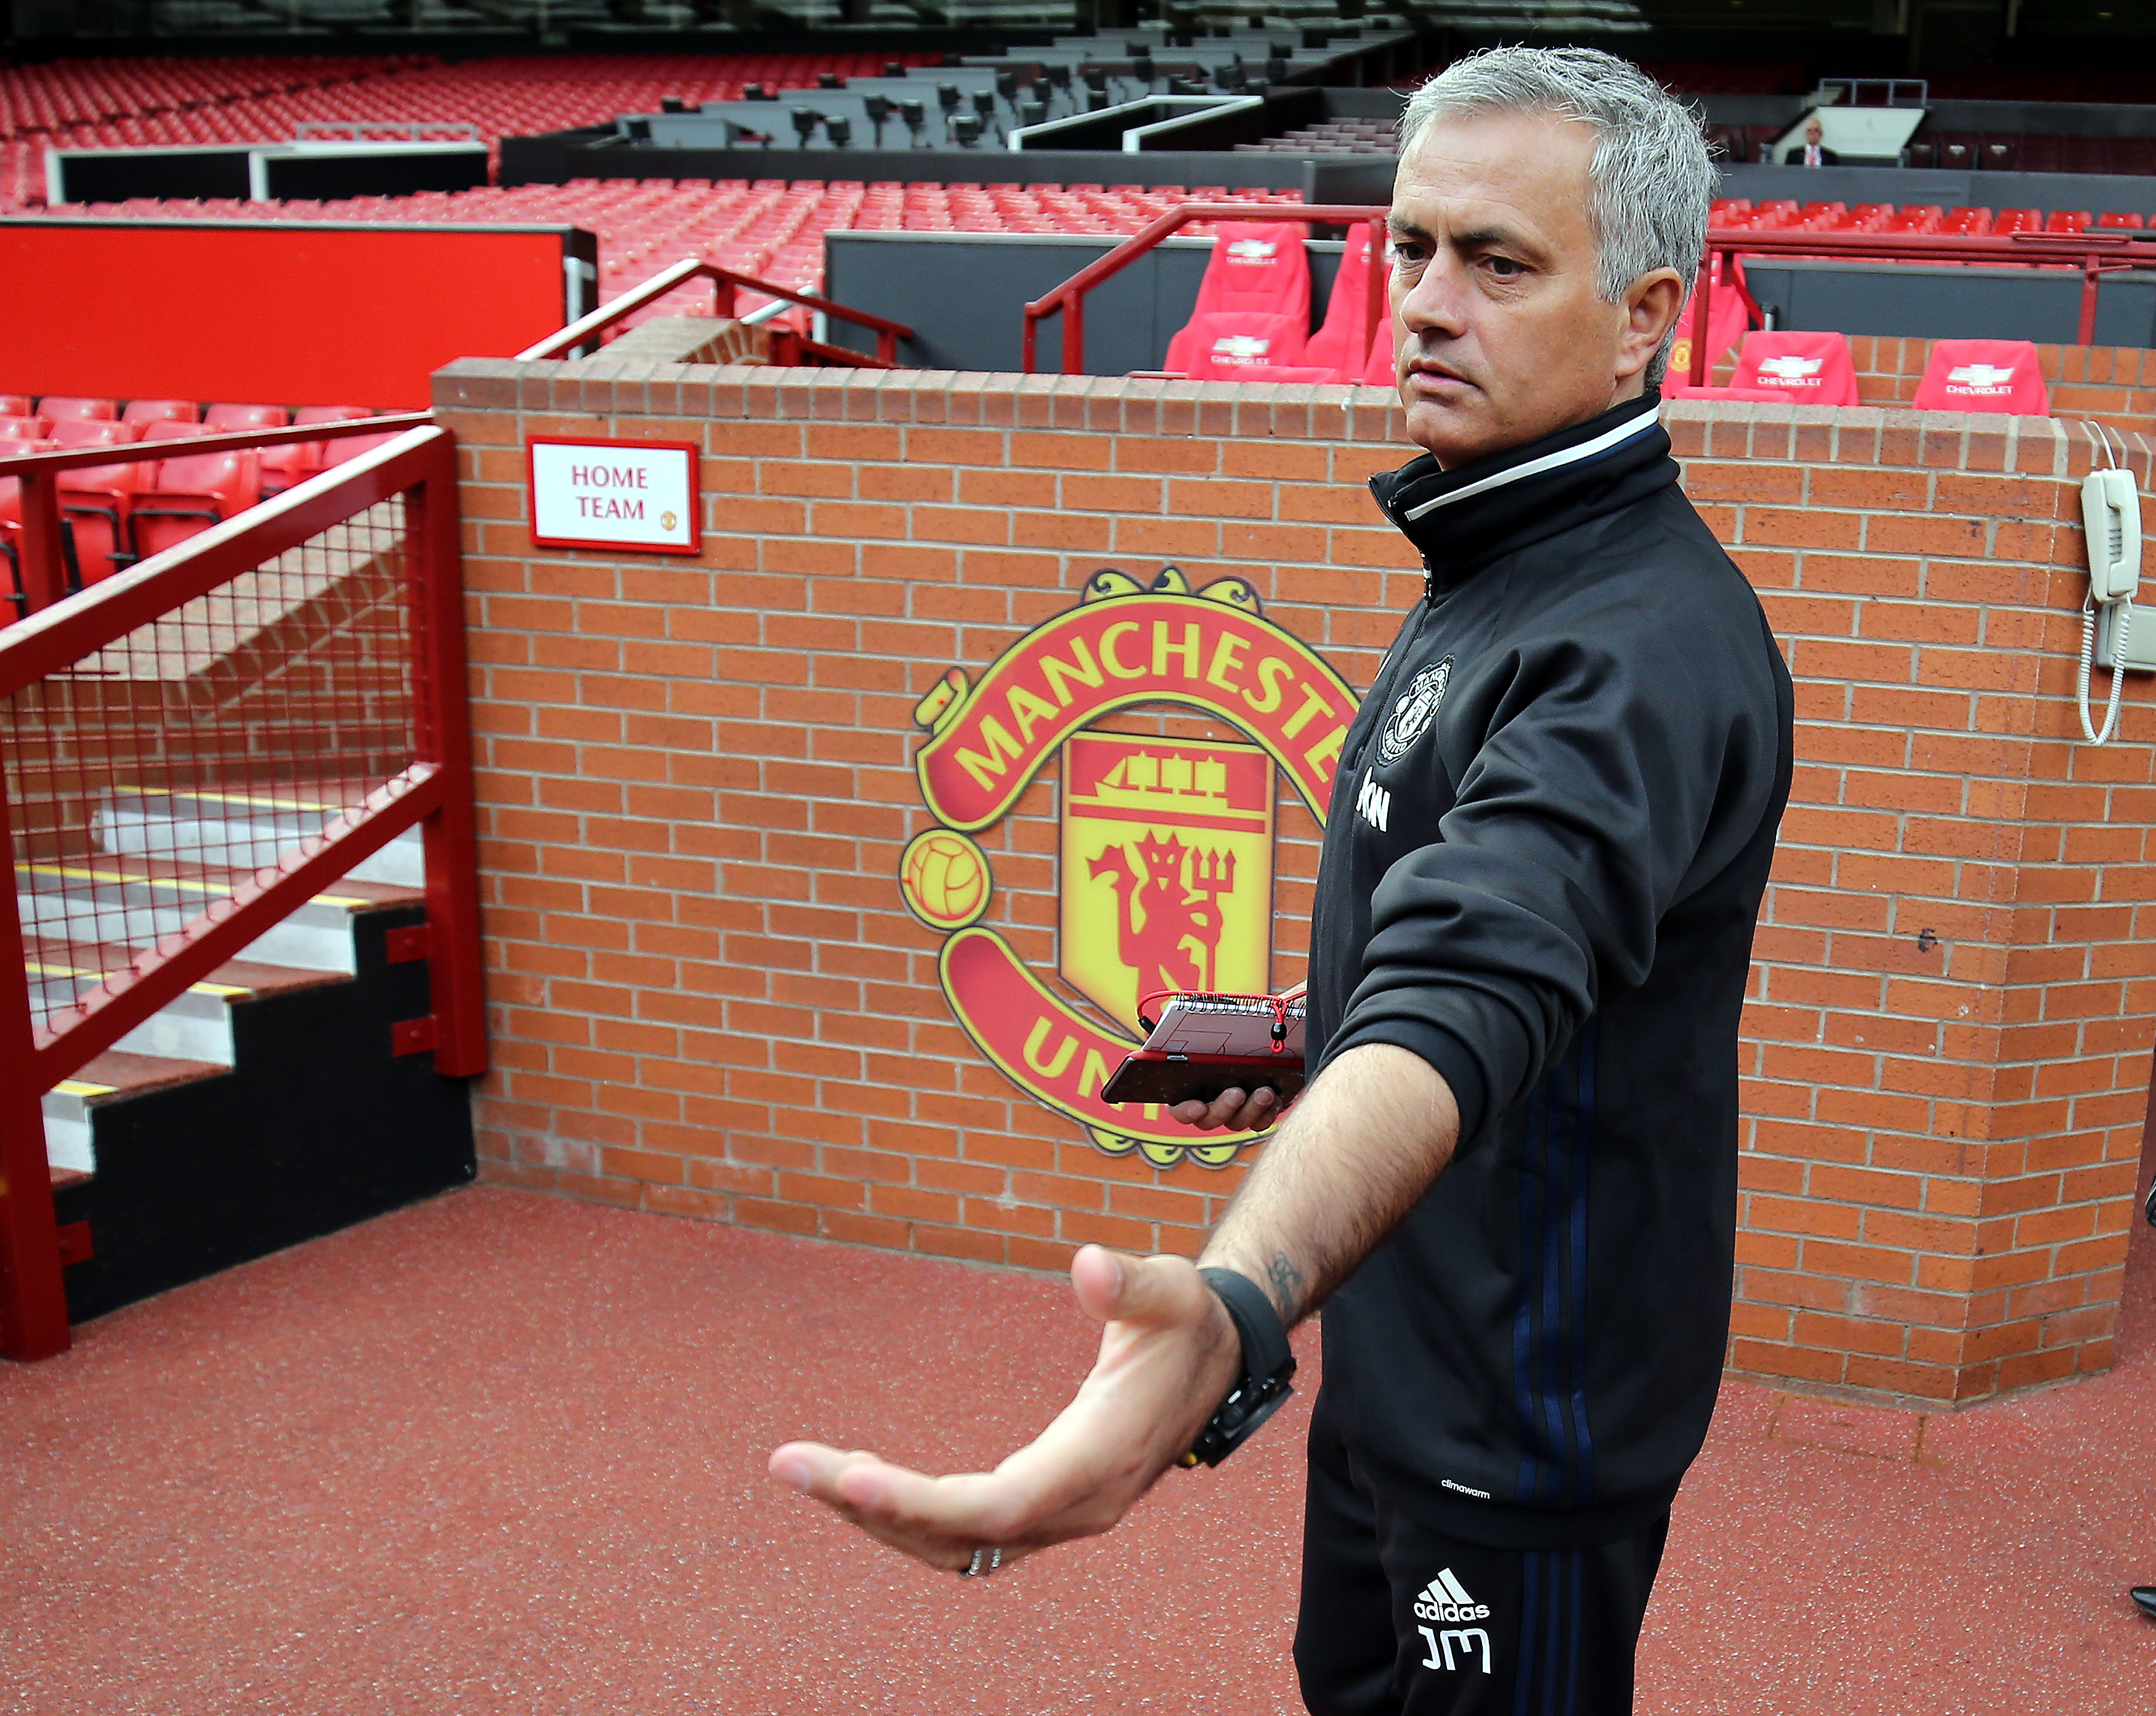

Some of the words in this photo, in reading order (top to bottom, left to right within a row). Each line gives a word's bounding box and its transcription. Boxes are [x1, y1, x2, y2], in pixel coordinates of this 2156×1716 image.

[1757, 376, 1822, 386] CHEVROLET
[1946, 384, 2013, 395] CHEVROLET
[572, 465, 649, 489] HOME
[576, 496, 644, 520] TEAM
[953, 620, 1349, 793] MANCHESTE
[1441, 1479, 1490, 1499] climawarm
[1413, 1601, 1490, 1622] adidas
[1417, 1625, 1491, 1674] JM
